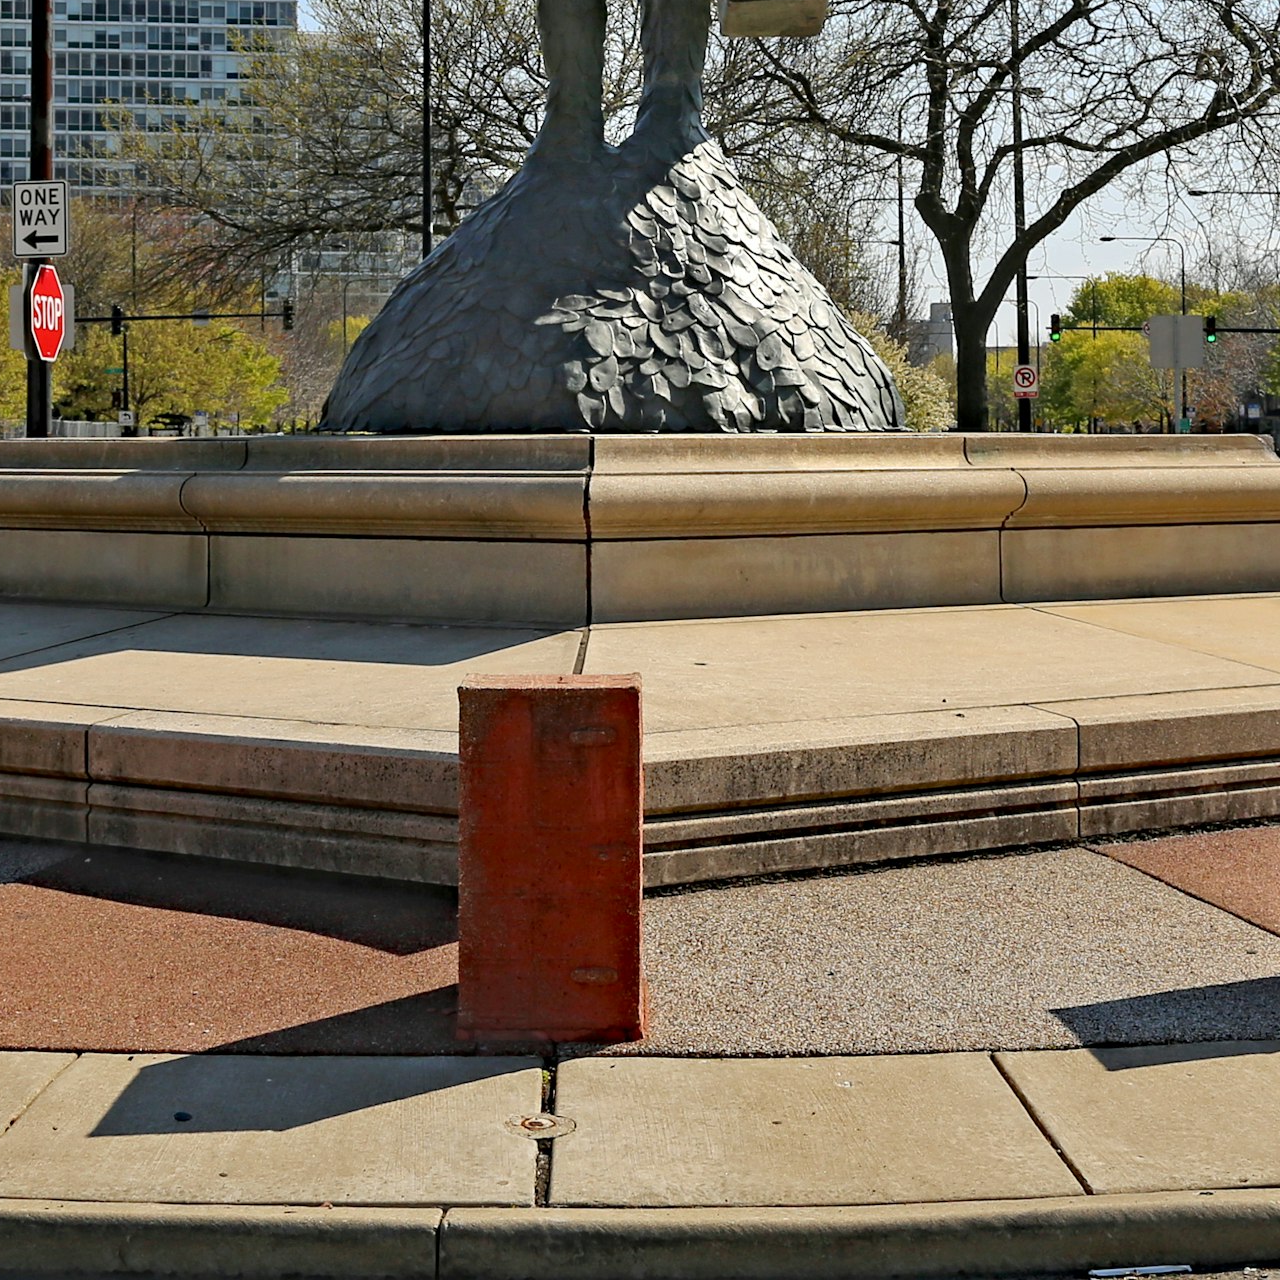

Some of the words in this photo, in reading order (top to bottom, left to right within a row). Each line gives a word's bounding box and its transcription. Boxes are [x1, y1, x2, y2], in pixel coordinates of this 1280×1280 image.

[21, 188, 59, 206] ONE
[19, 208, 60, 226] WAY
[33, 294, 62, 331] STOP
